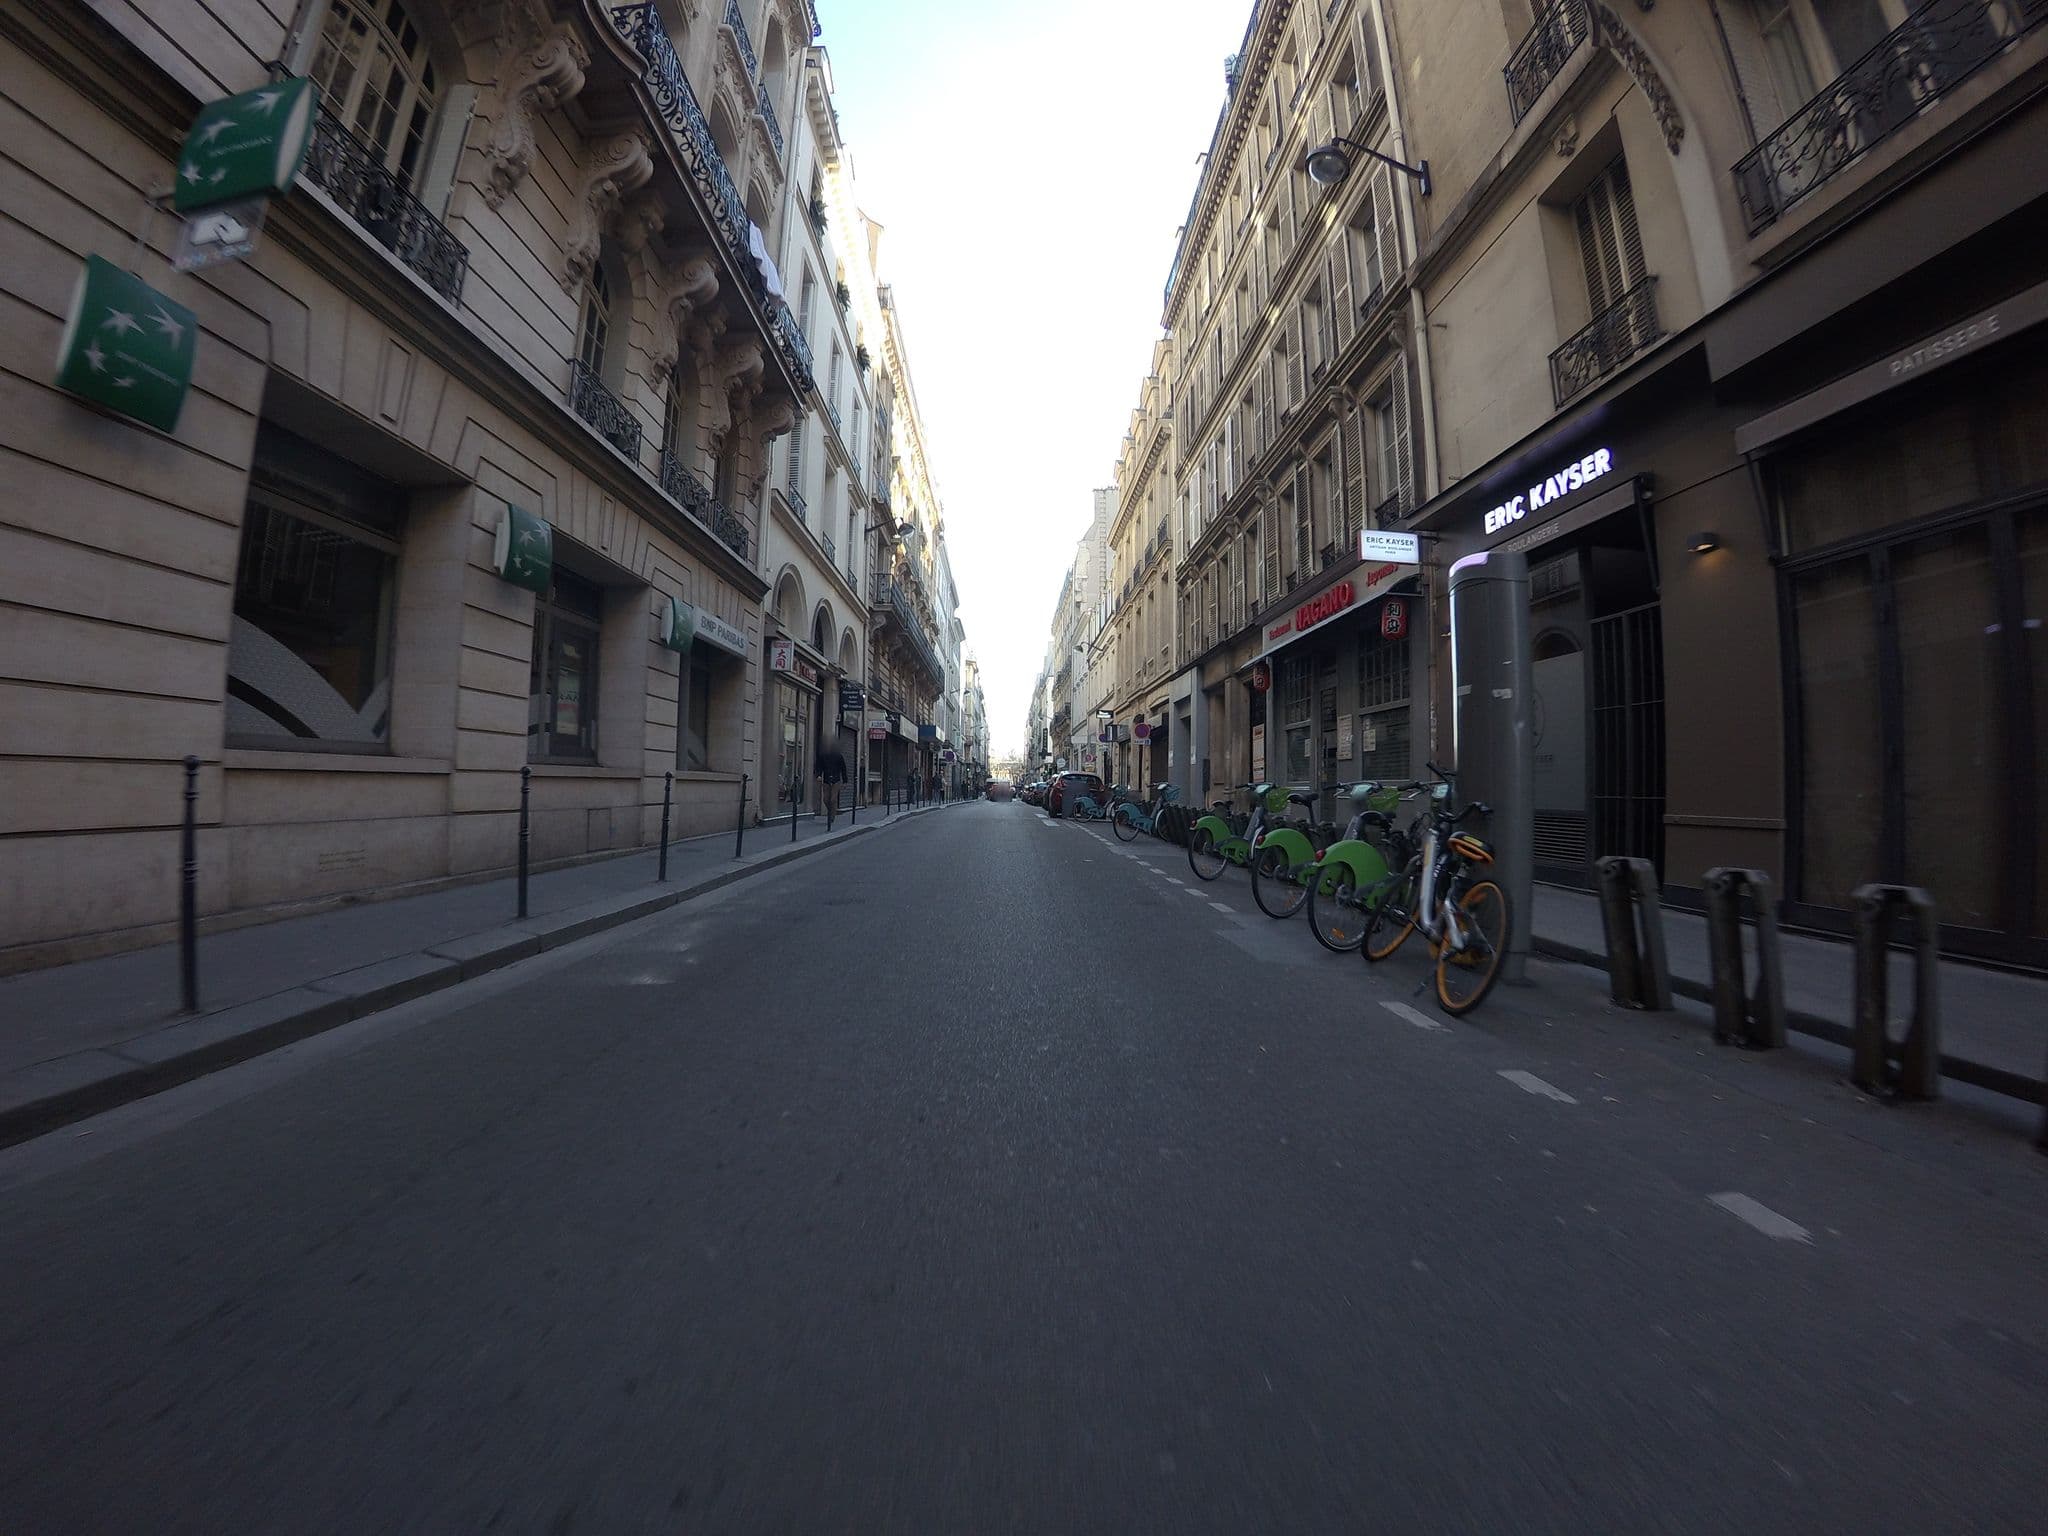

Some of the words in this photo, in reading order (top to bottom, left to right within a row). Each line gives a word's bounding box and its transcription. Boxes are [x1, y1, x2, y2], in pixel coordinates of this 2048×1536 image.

[1484, 496, 1526, 535] ERIC
[1529, 448, 1612, 511] KAYSER
[1366, 536, 1384, 544] ERIC
[1386, 538, 1414, 547] KAYSER
[1294, 581, 1355, 632] NAGANO
[700, 615, 717, 633] BNP
[717, 624, 745, 649] PARIBAS
